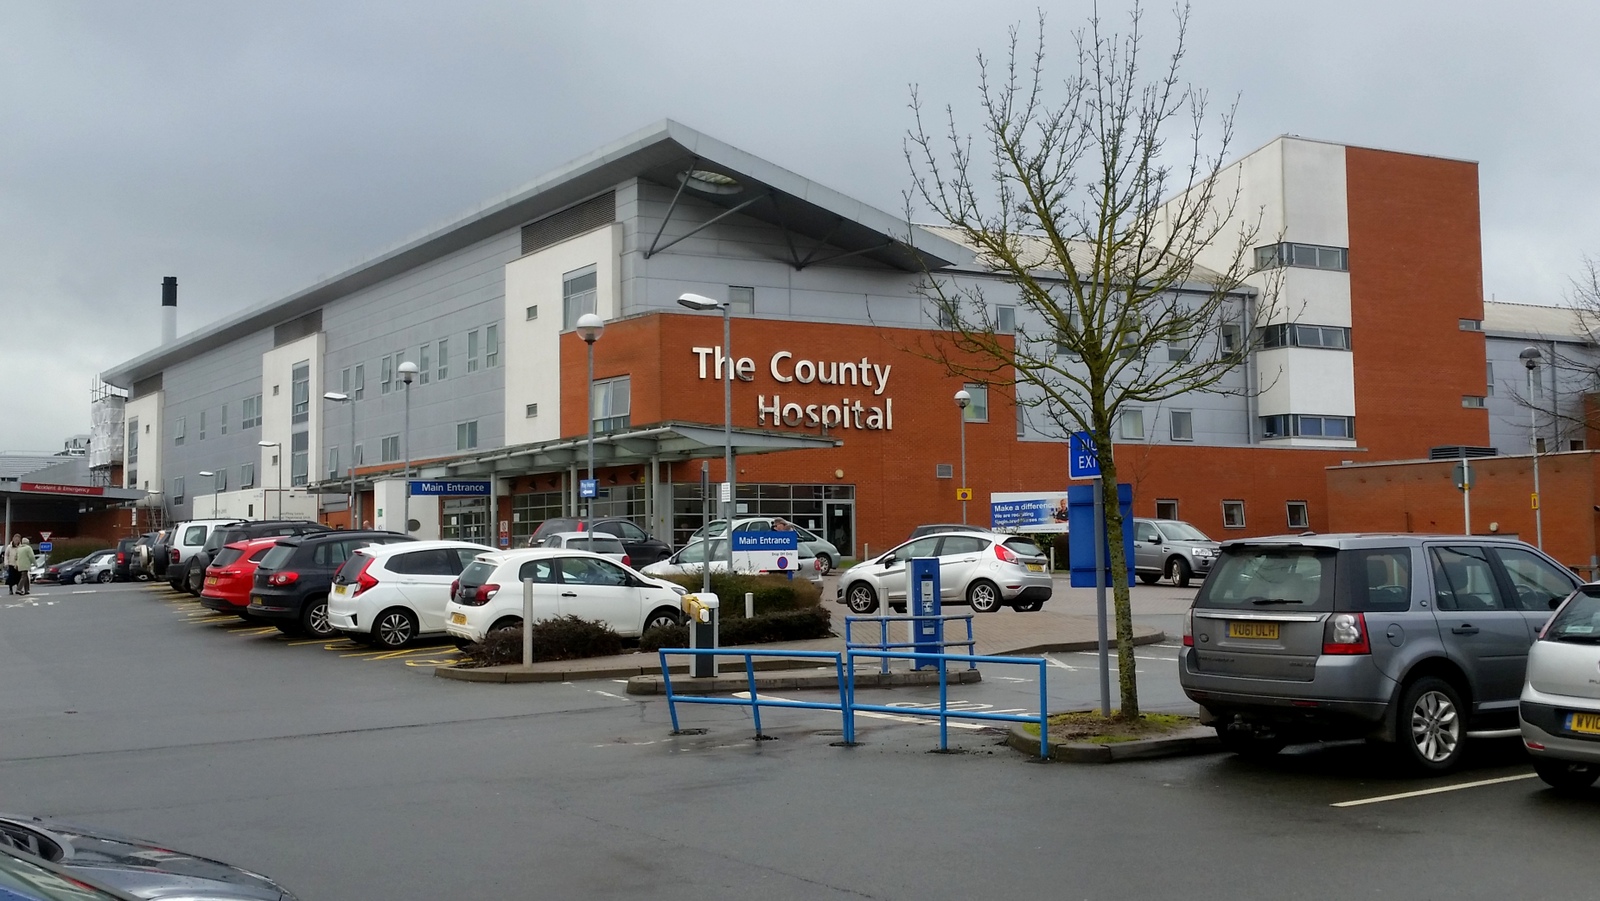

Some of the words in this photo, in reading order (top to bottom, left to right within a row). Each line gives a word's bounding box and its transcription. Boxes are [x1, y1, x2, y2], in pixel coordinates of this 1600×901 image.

[692, 346, 756, 381] The
[770, 351, 892, 395] County
[758, 394, 893, 436] Hospital
[1078, 454, 1099, 469] EXI
[421, 483, 444, 491] Main
[447, 483, 484, 492] Entrance
[738, 536, 758, 545] Main
[760, 536, 791, 545] Entrance
[1255, 624, 1276, 637] ULH
